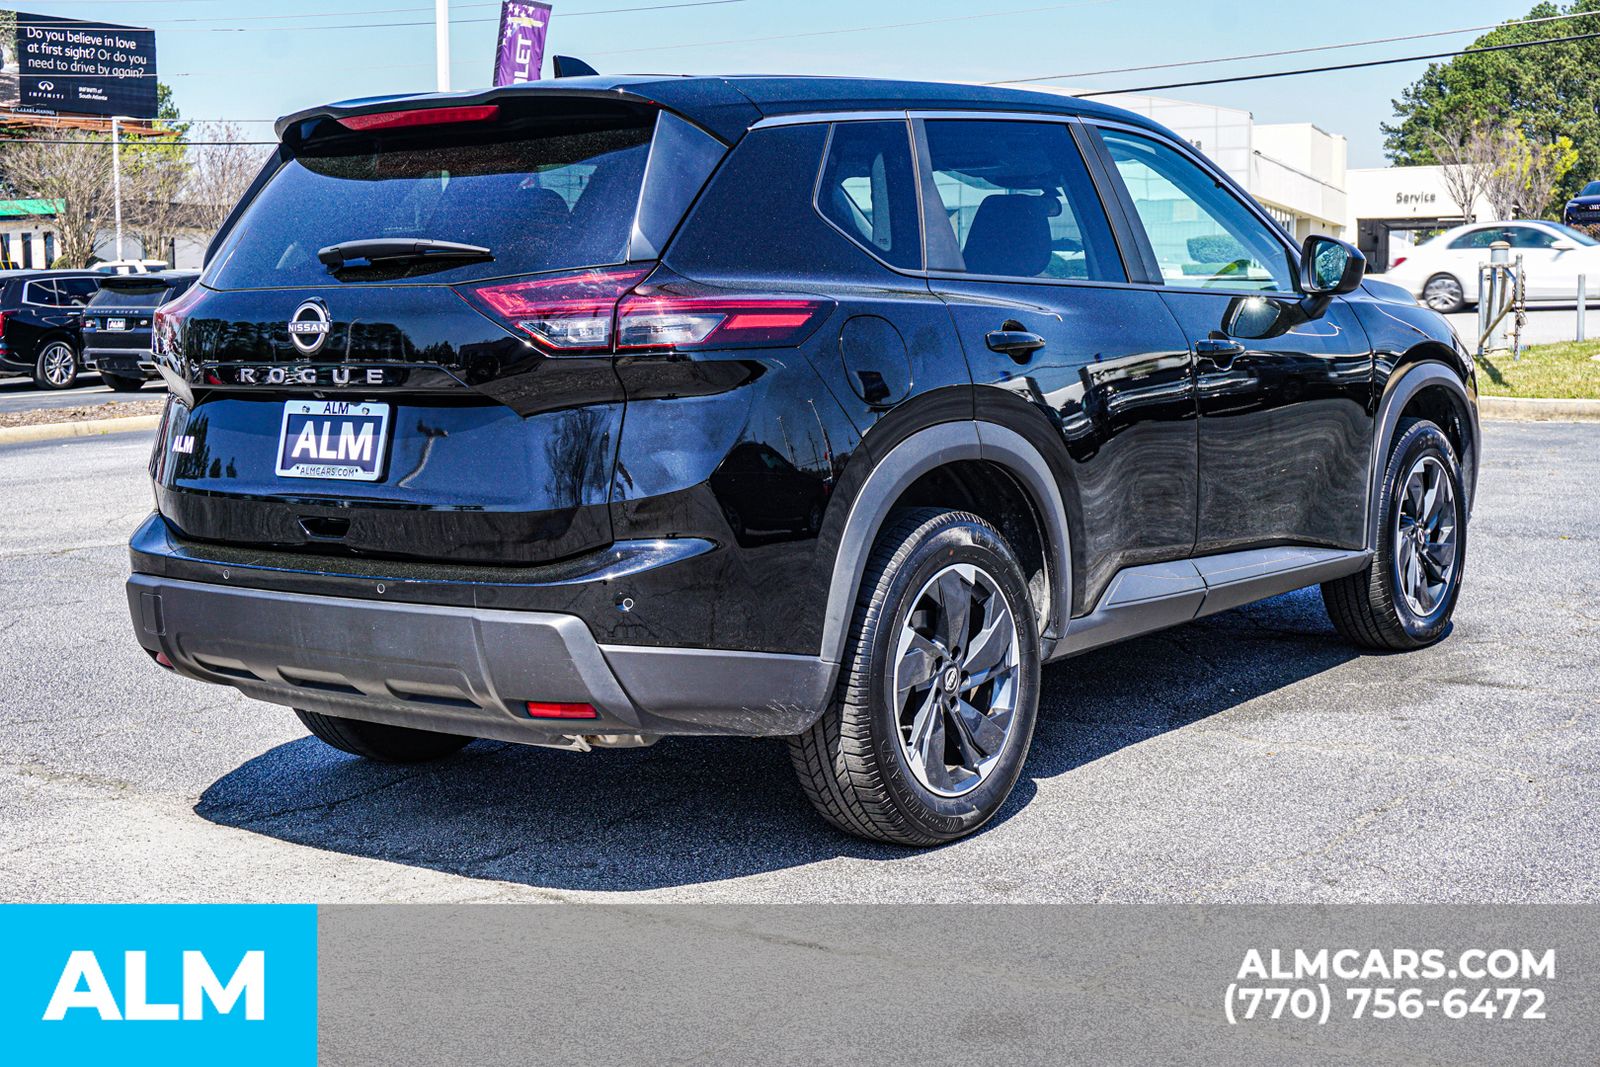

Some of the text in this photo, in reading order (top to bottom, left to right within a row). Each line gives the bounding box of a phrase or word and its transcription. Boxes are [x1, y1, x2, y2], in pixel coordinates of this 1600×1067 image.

[27, 27, 137, 49] Do you believe in love
[27, 43, 147, 66] at first sight? Or do you
[28, 58, 145, 79] need to drive by again?
[28, 91, 64, 99] INFINITI
[1396, 191, 1436, 204] Service
[288, 322, 329, 333] NISSAN
[240, 368, 383, 384] ROGUE
[323, 402, 350, 415] ALM
[172, 435, 195, 454] ALM
[291, 420, 375, 461] ALM
[300, 467, 355, 477] ALMCARS.COM
